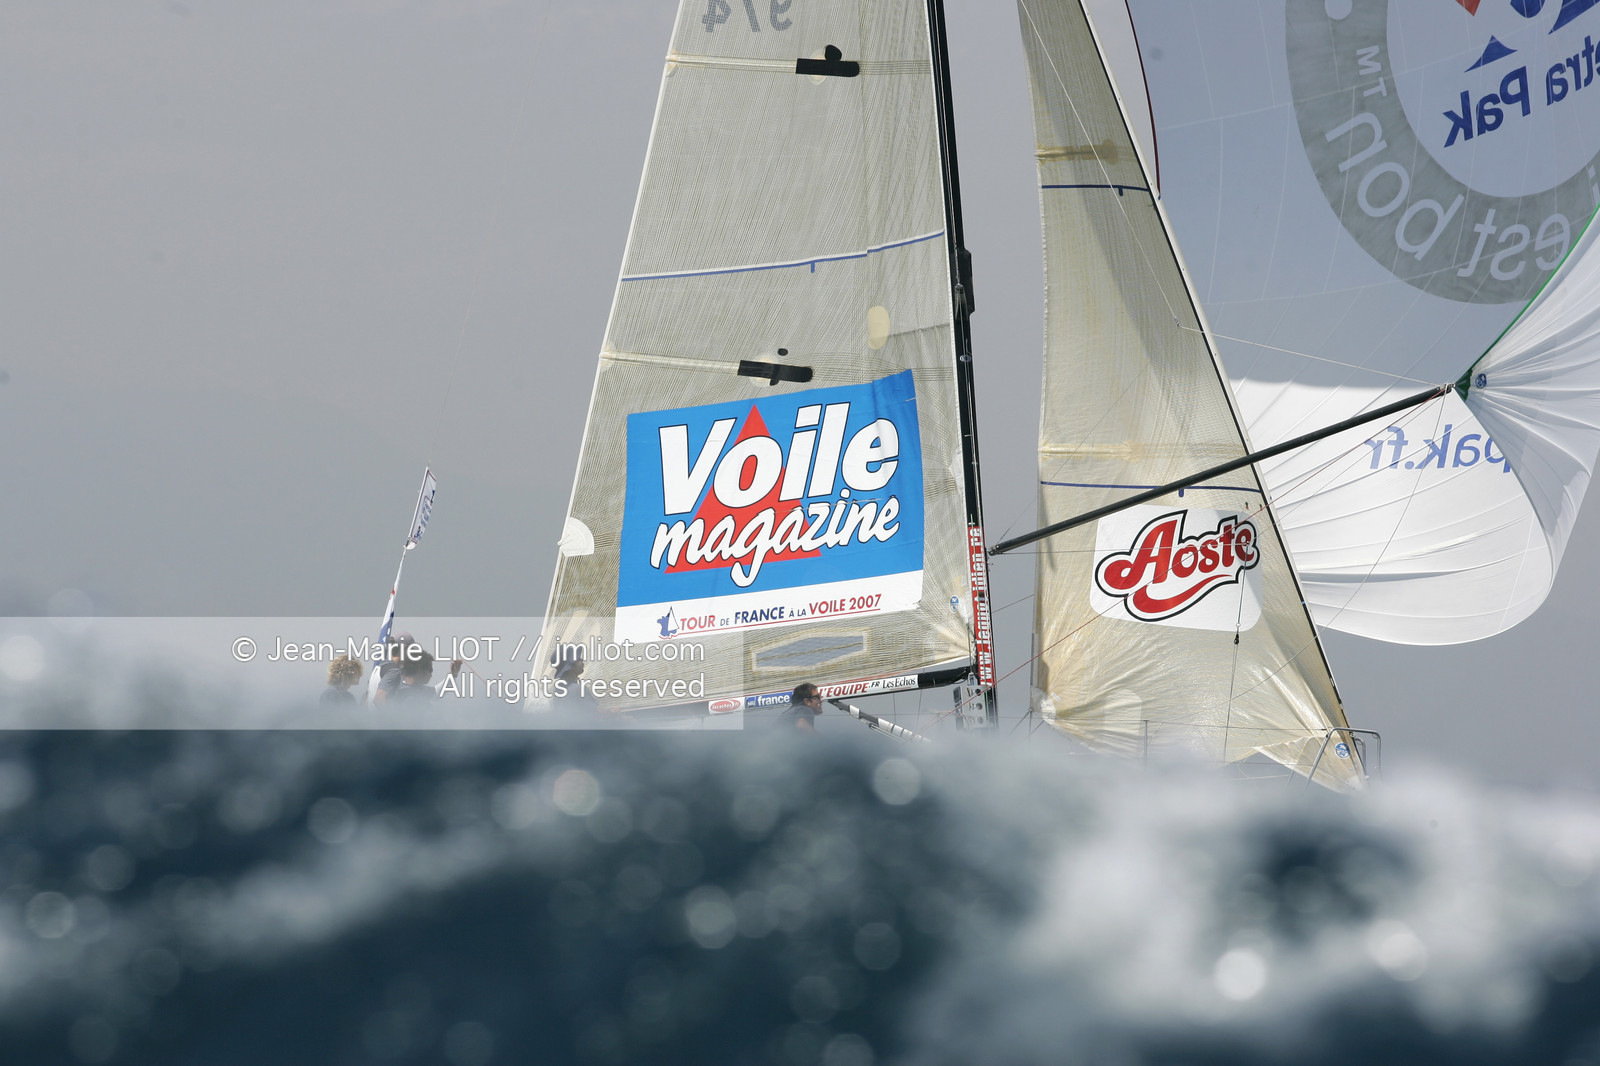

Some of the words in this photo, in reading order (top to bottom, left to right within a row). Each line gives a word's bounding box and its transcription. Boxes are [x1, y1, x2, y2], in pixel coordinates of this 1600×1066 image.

[658, 401, 900, 517] Voile
[649, 487, 900, 588] magazine
[1102, 517, 1256, 592] Aoste
[680, 614, 717, 631] TOUR
[719, 617, 730, 627] DE
[734, 606, 786, 625] FRANCE
[797, 608, 807, 617] LA
[808, 598, 846, 616] VOILE
[849, 593, 882, 610] 2007
[757, 694, 791, 707] france
